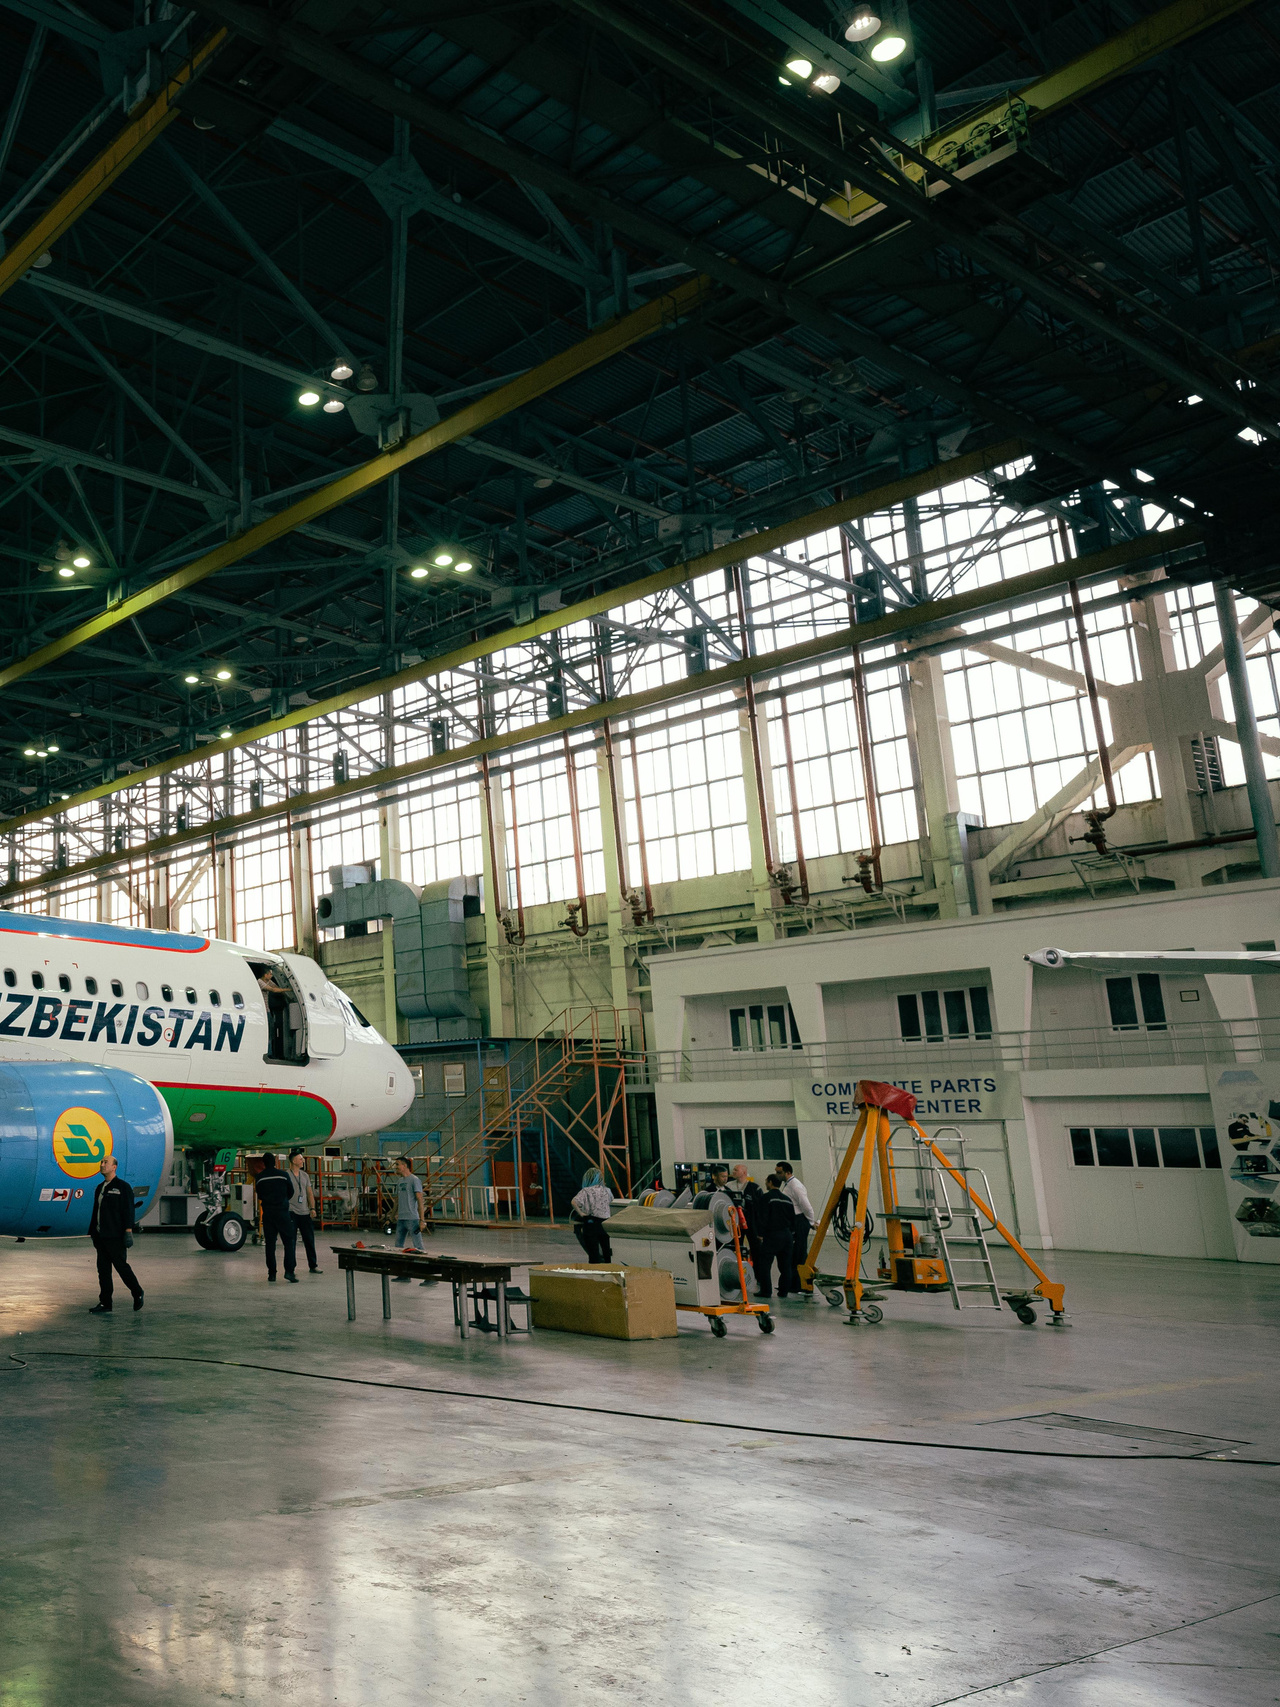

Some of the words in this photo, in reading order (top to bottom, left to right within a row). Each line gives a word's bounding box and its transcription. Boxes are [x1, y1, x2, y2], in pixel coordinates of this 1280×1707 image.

[931, 1078, 997, 1094] PARTS
[915, 1099, 982, 1114] ENTER
[221, 1151, 231, 1163] 16
